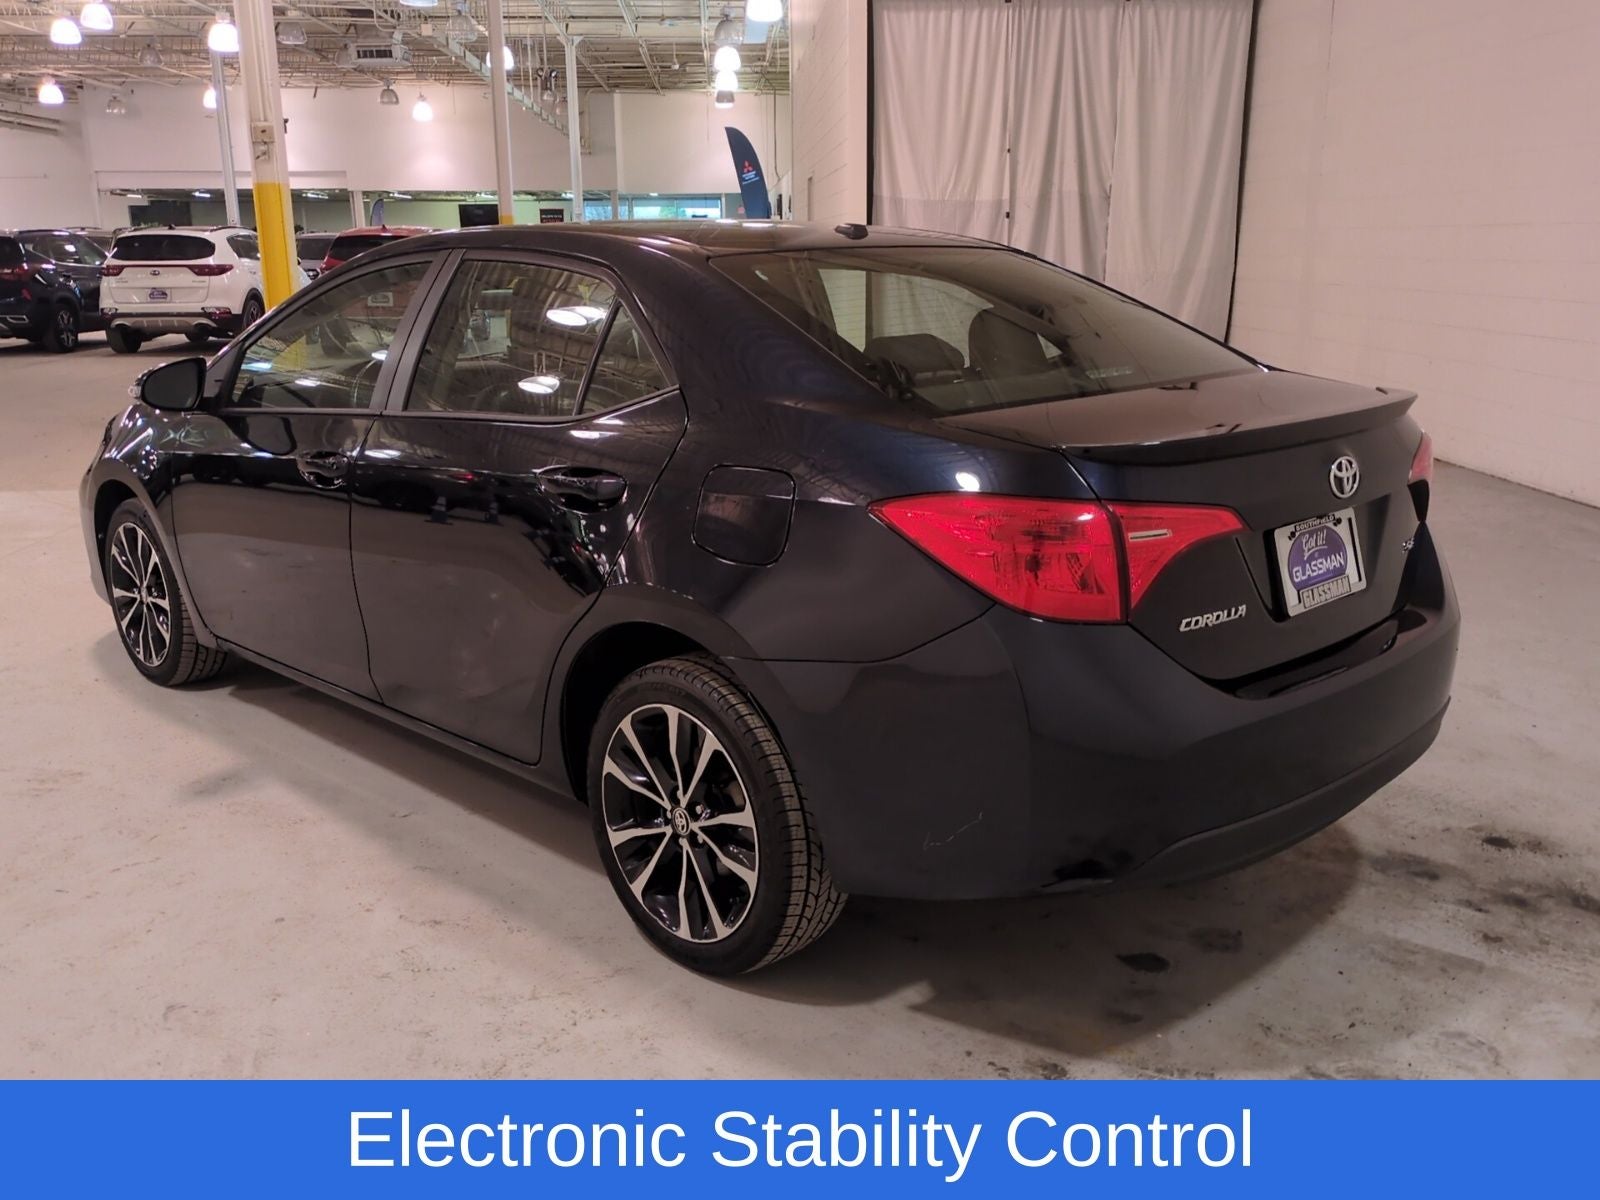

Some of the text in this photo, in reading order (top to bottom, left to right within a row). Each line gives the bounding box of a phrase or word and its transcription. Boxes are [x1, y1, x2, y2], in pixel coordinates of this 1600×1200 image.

[1295, 514, 1335, 531] SOUTHFIELD
[1302, 531, 1317, 552] Got
[1292, 551, 1345, 583] GLASSMAN
[1303, 575, 1350, 607] GLASSMAN
[1179, 604, 1247, 632] COROLLA
